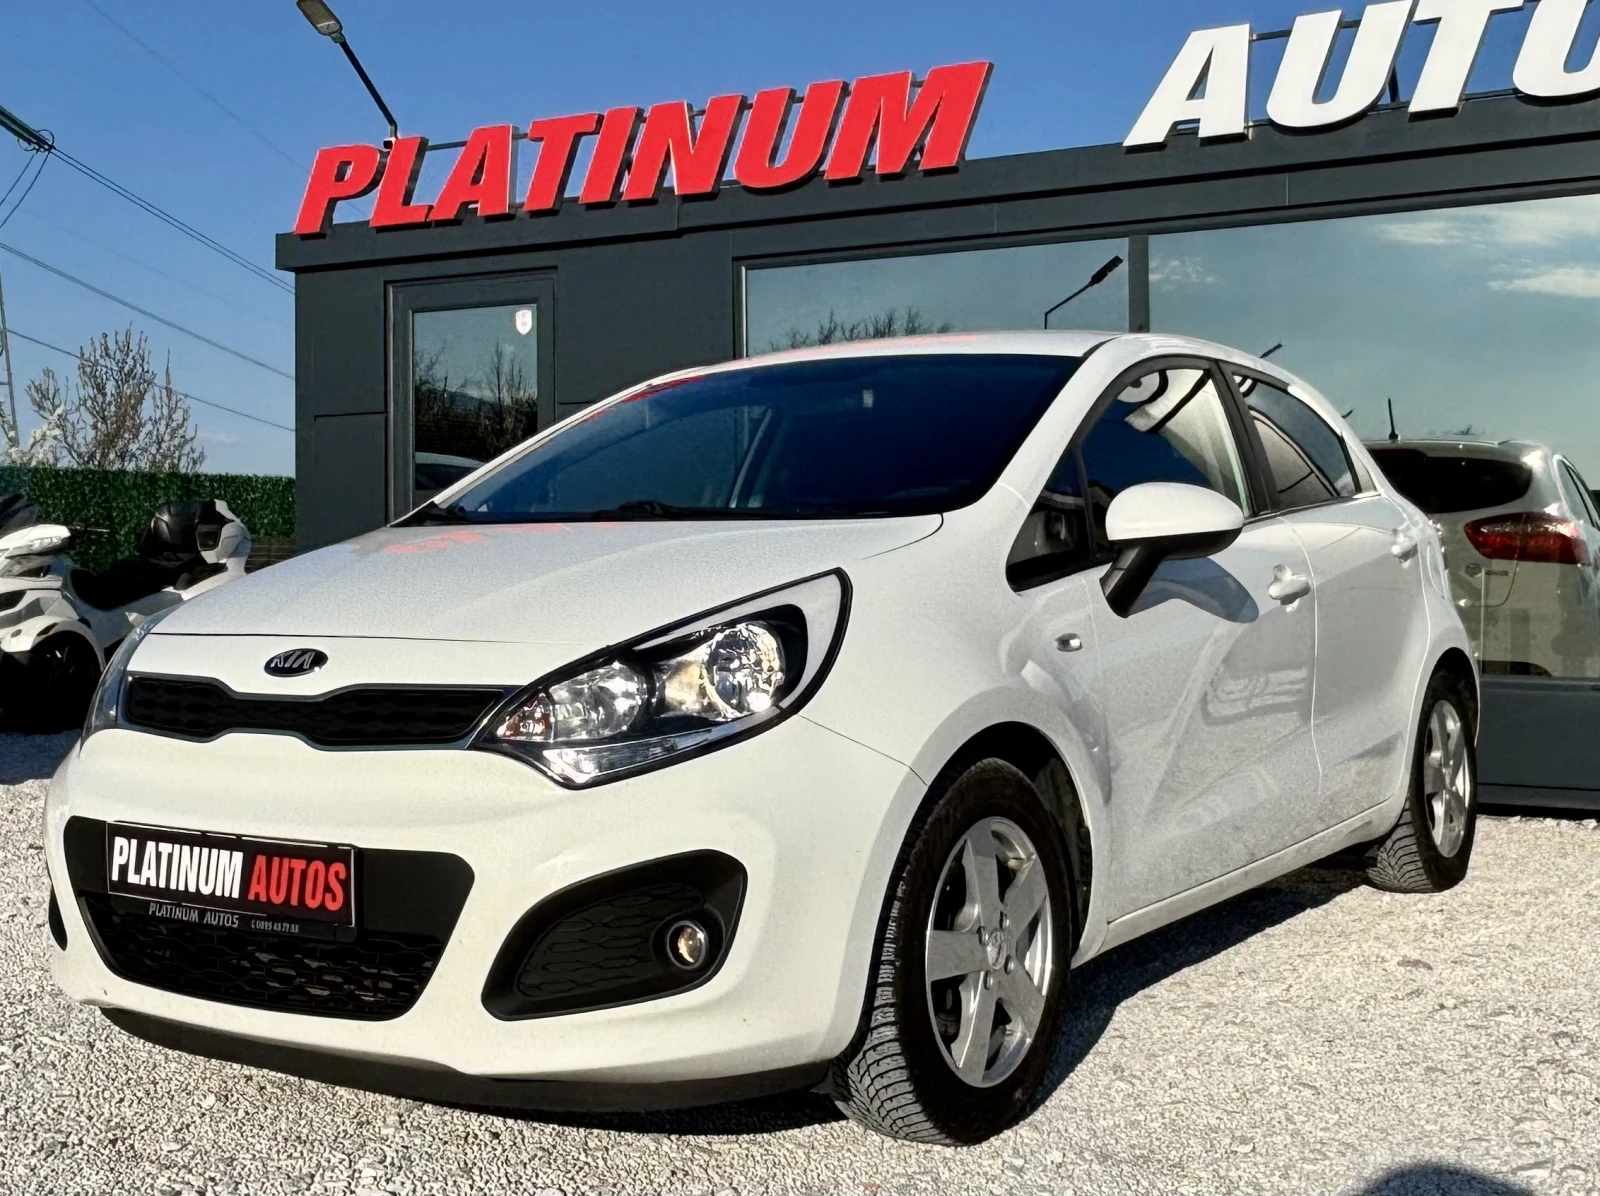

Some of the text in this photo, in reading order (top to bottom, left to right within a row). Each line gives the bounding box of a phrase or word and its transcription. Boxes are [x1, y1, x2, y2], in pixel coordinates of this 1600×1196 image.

[294, 61, 990, 236] PLATINUM
[270, 650, 316, 669] KIA
[111, 836, 346, 911] PLATINUM AUTOS
[148, 902, 199, 923] PLATINUM
[203, 911, 239, 928] AUTOS
